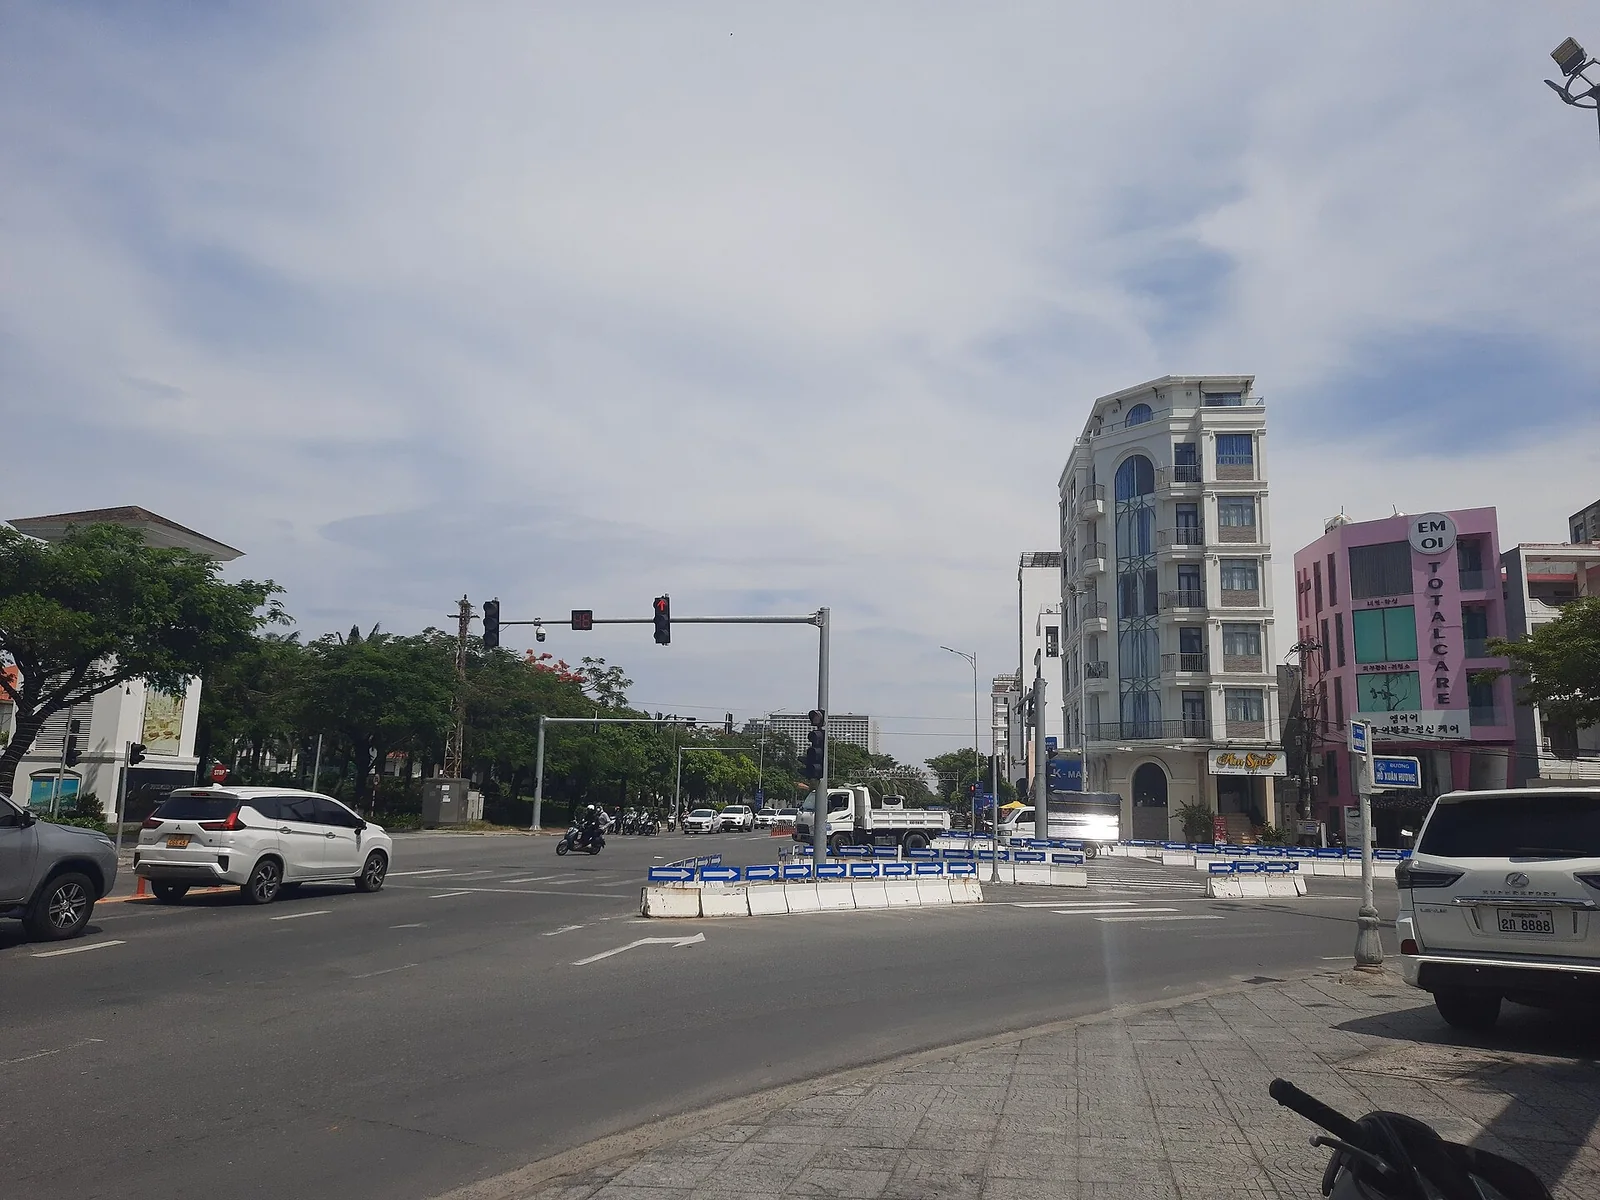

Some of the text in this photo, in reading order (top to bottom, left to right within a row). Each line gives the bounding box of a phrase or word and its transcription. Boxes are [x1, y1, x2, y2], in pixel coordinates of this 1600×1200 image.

[1418, 521, 1446, 533] EM
[1421, 537, 1443, 549] OI
[1521, 919, 1551, 932] 8888
